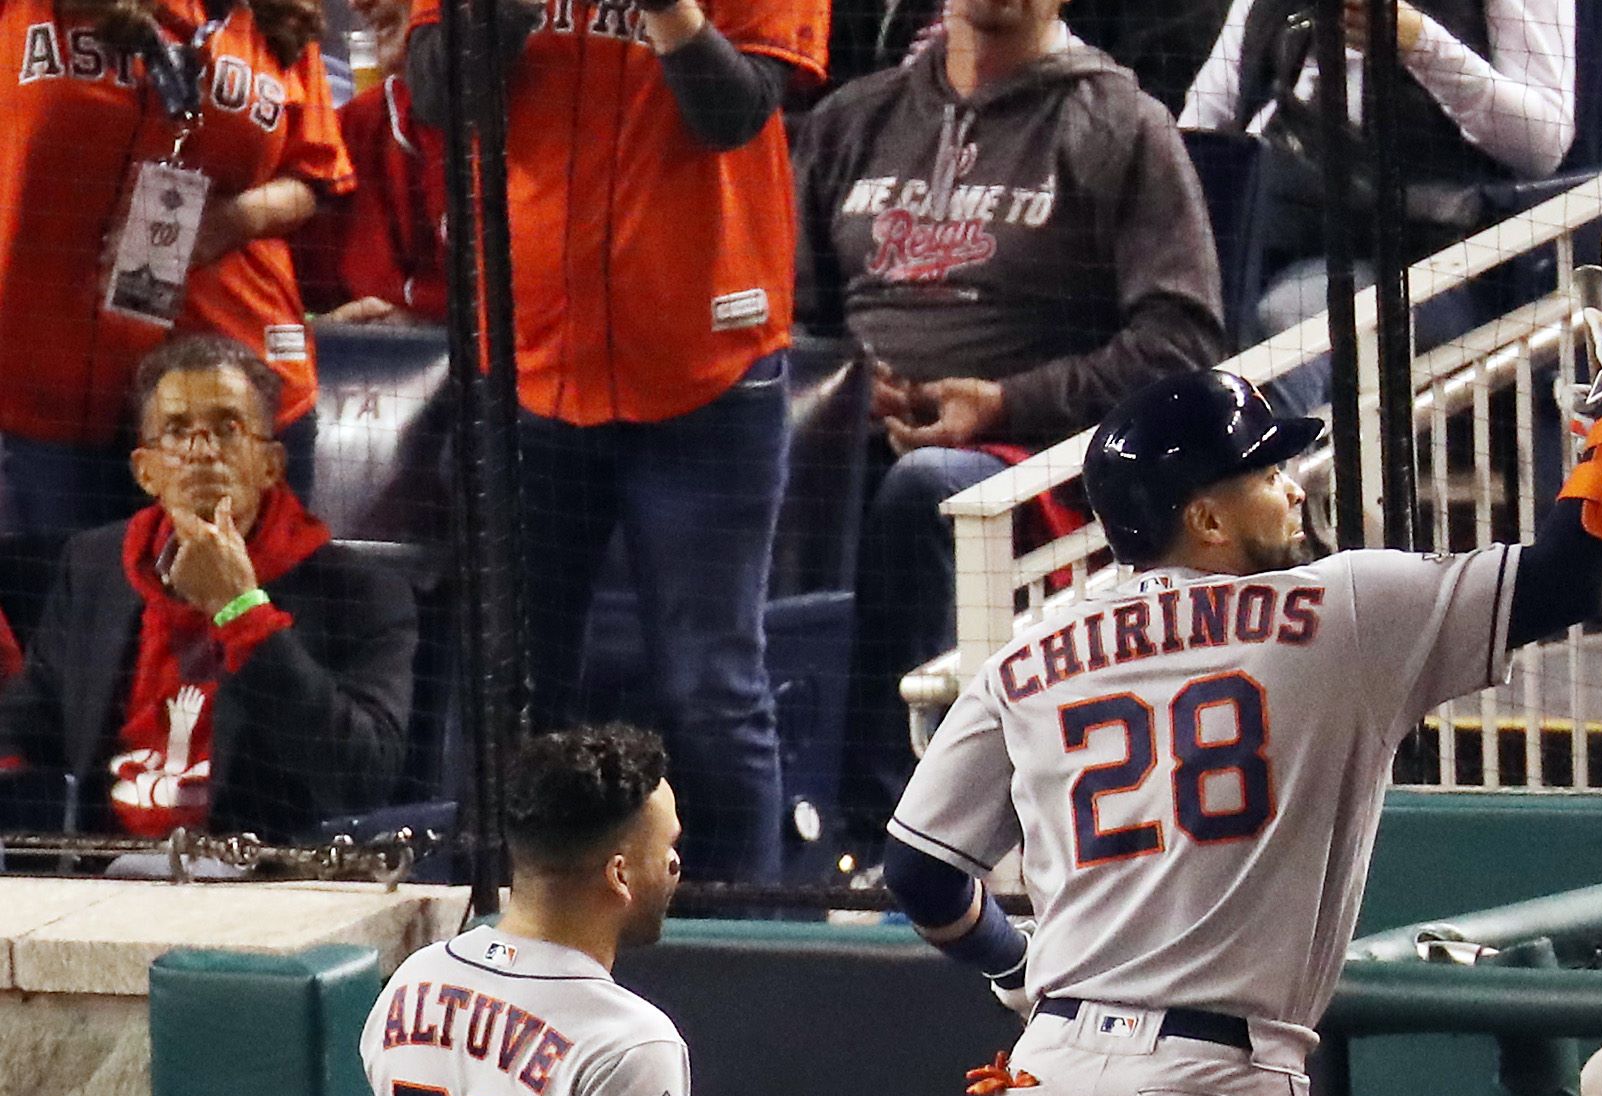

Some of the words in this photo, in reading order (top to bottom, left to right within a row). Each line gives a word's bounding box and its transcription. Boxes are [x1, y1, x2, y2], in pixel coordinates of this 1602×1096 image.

[19, 21, 286, 133] ASTOS
[998, 583, 1326, 703] CHIRINOS
[1058, 669, 1278, 870] 28
[382, 981, 574, 1096] ALTUVE
